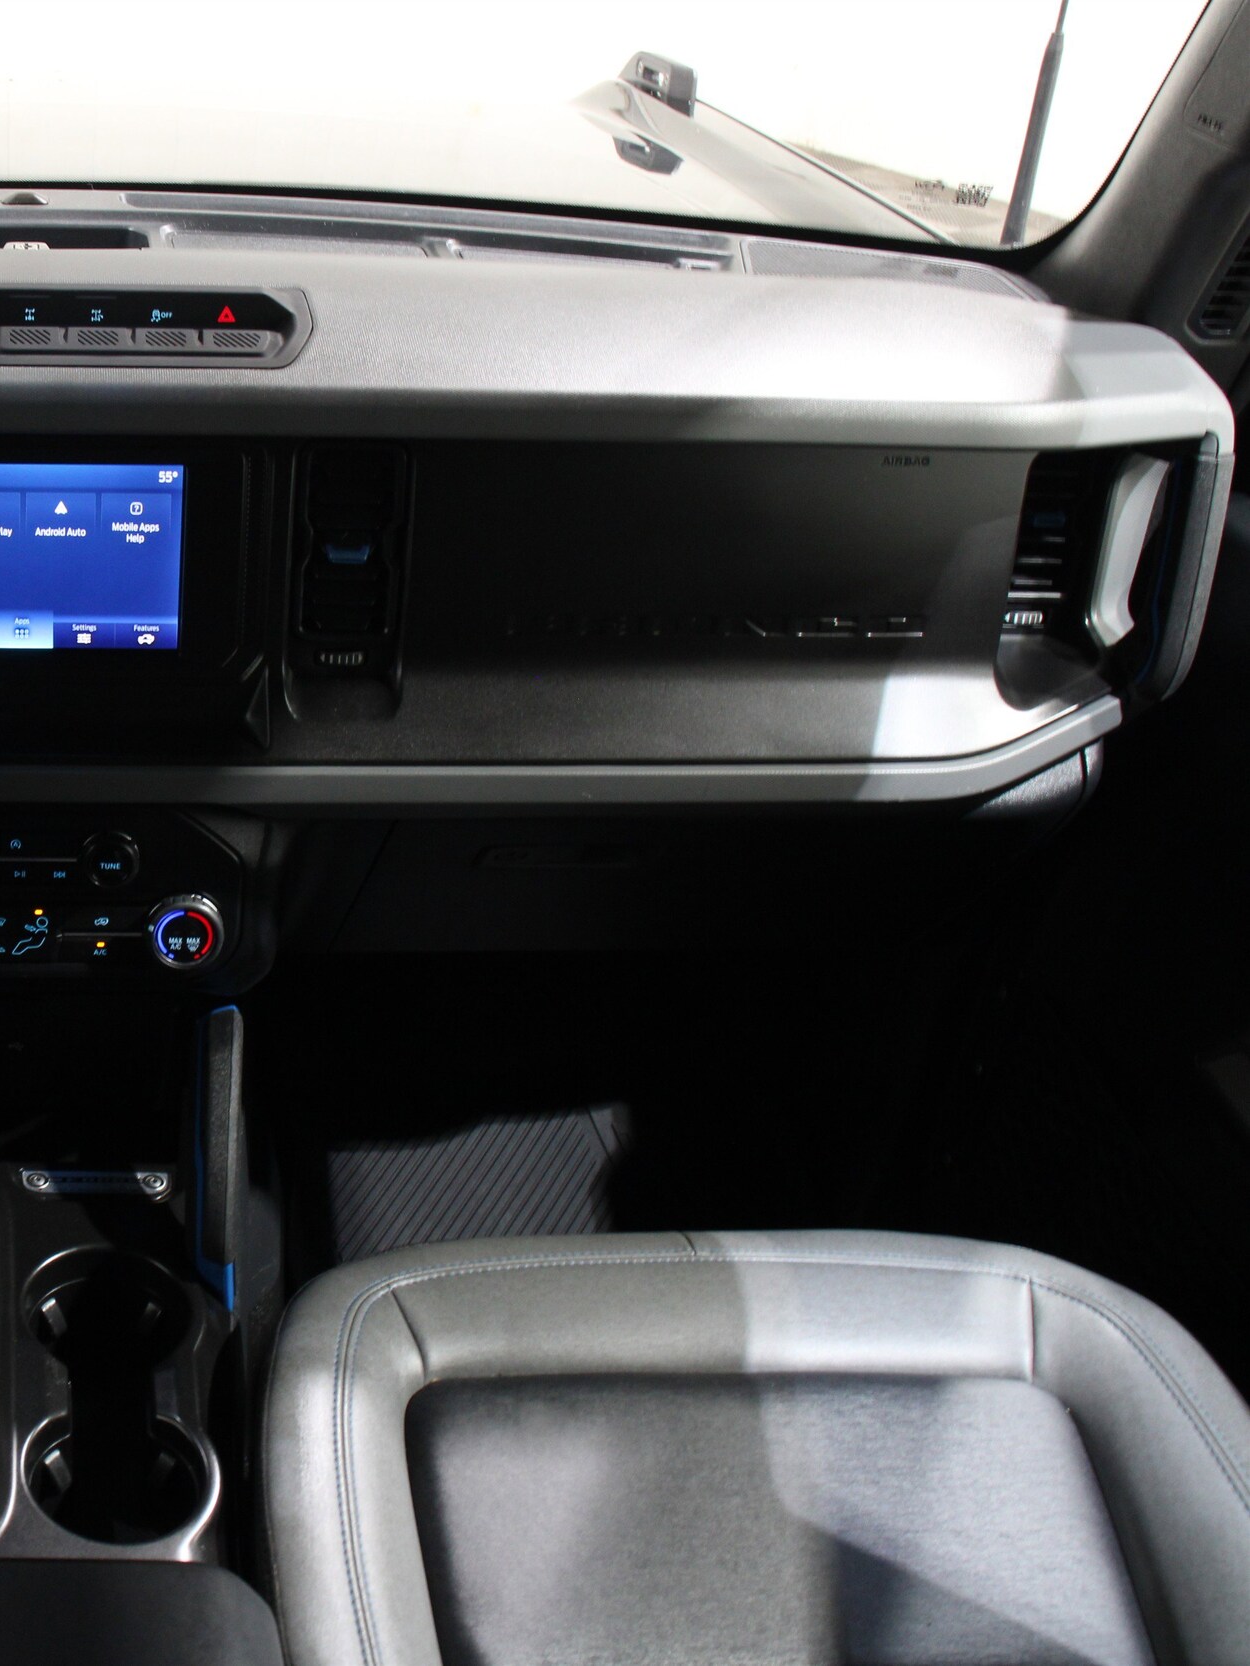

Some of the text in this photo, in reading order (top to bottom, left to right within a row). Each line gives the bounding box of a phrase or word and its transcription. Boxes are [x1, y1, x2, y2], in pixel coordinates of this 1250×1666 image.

[160, 311, 173, 319] OFF
[35, 526, 86, 537] Android Auto
[111, 522, 160, 534] Mobile Apps
[126, 533, 145, 545] Help
[14, 617, 30, 626] Apps
[71, 623, 97, 633] Settings
[133, 624, 160, 632] Features
[100, 862, 121, 870] TUNE
